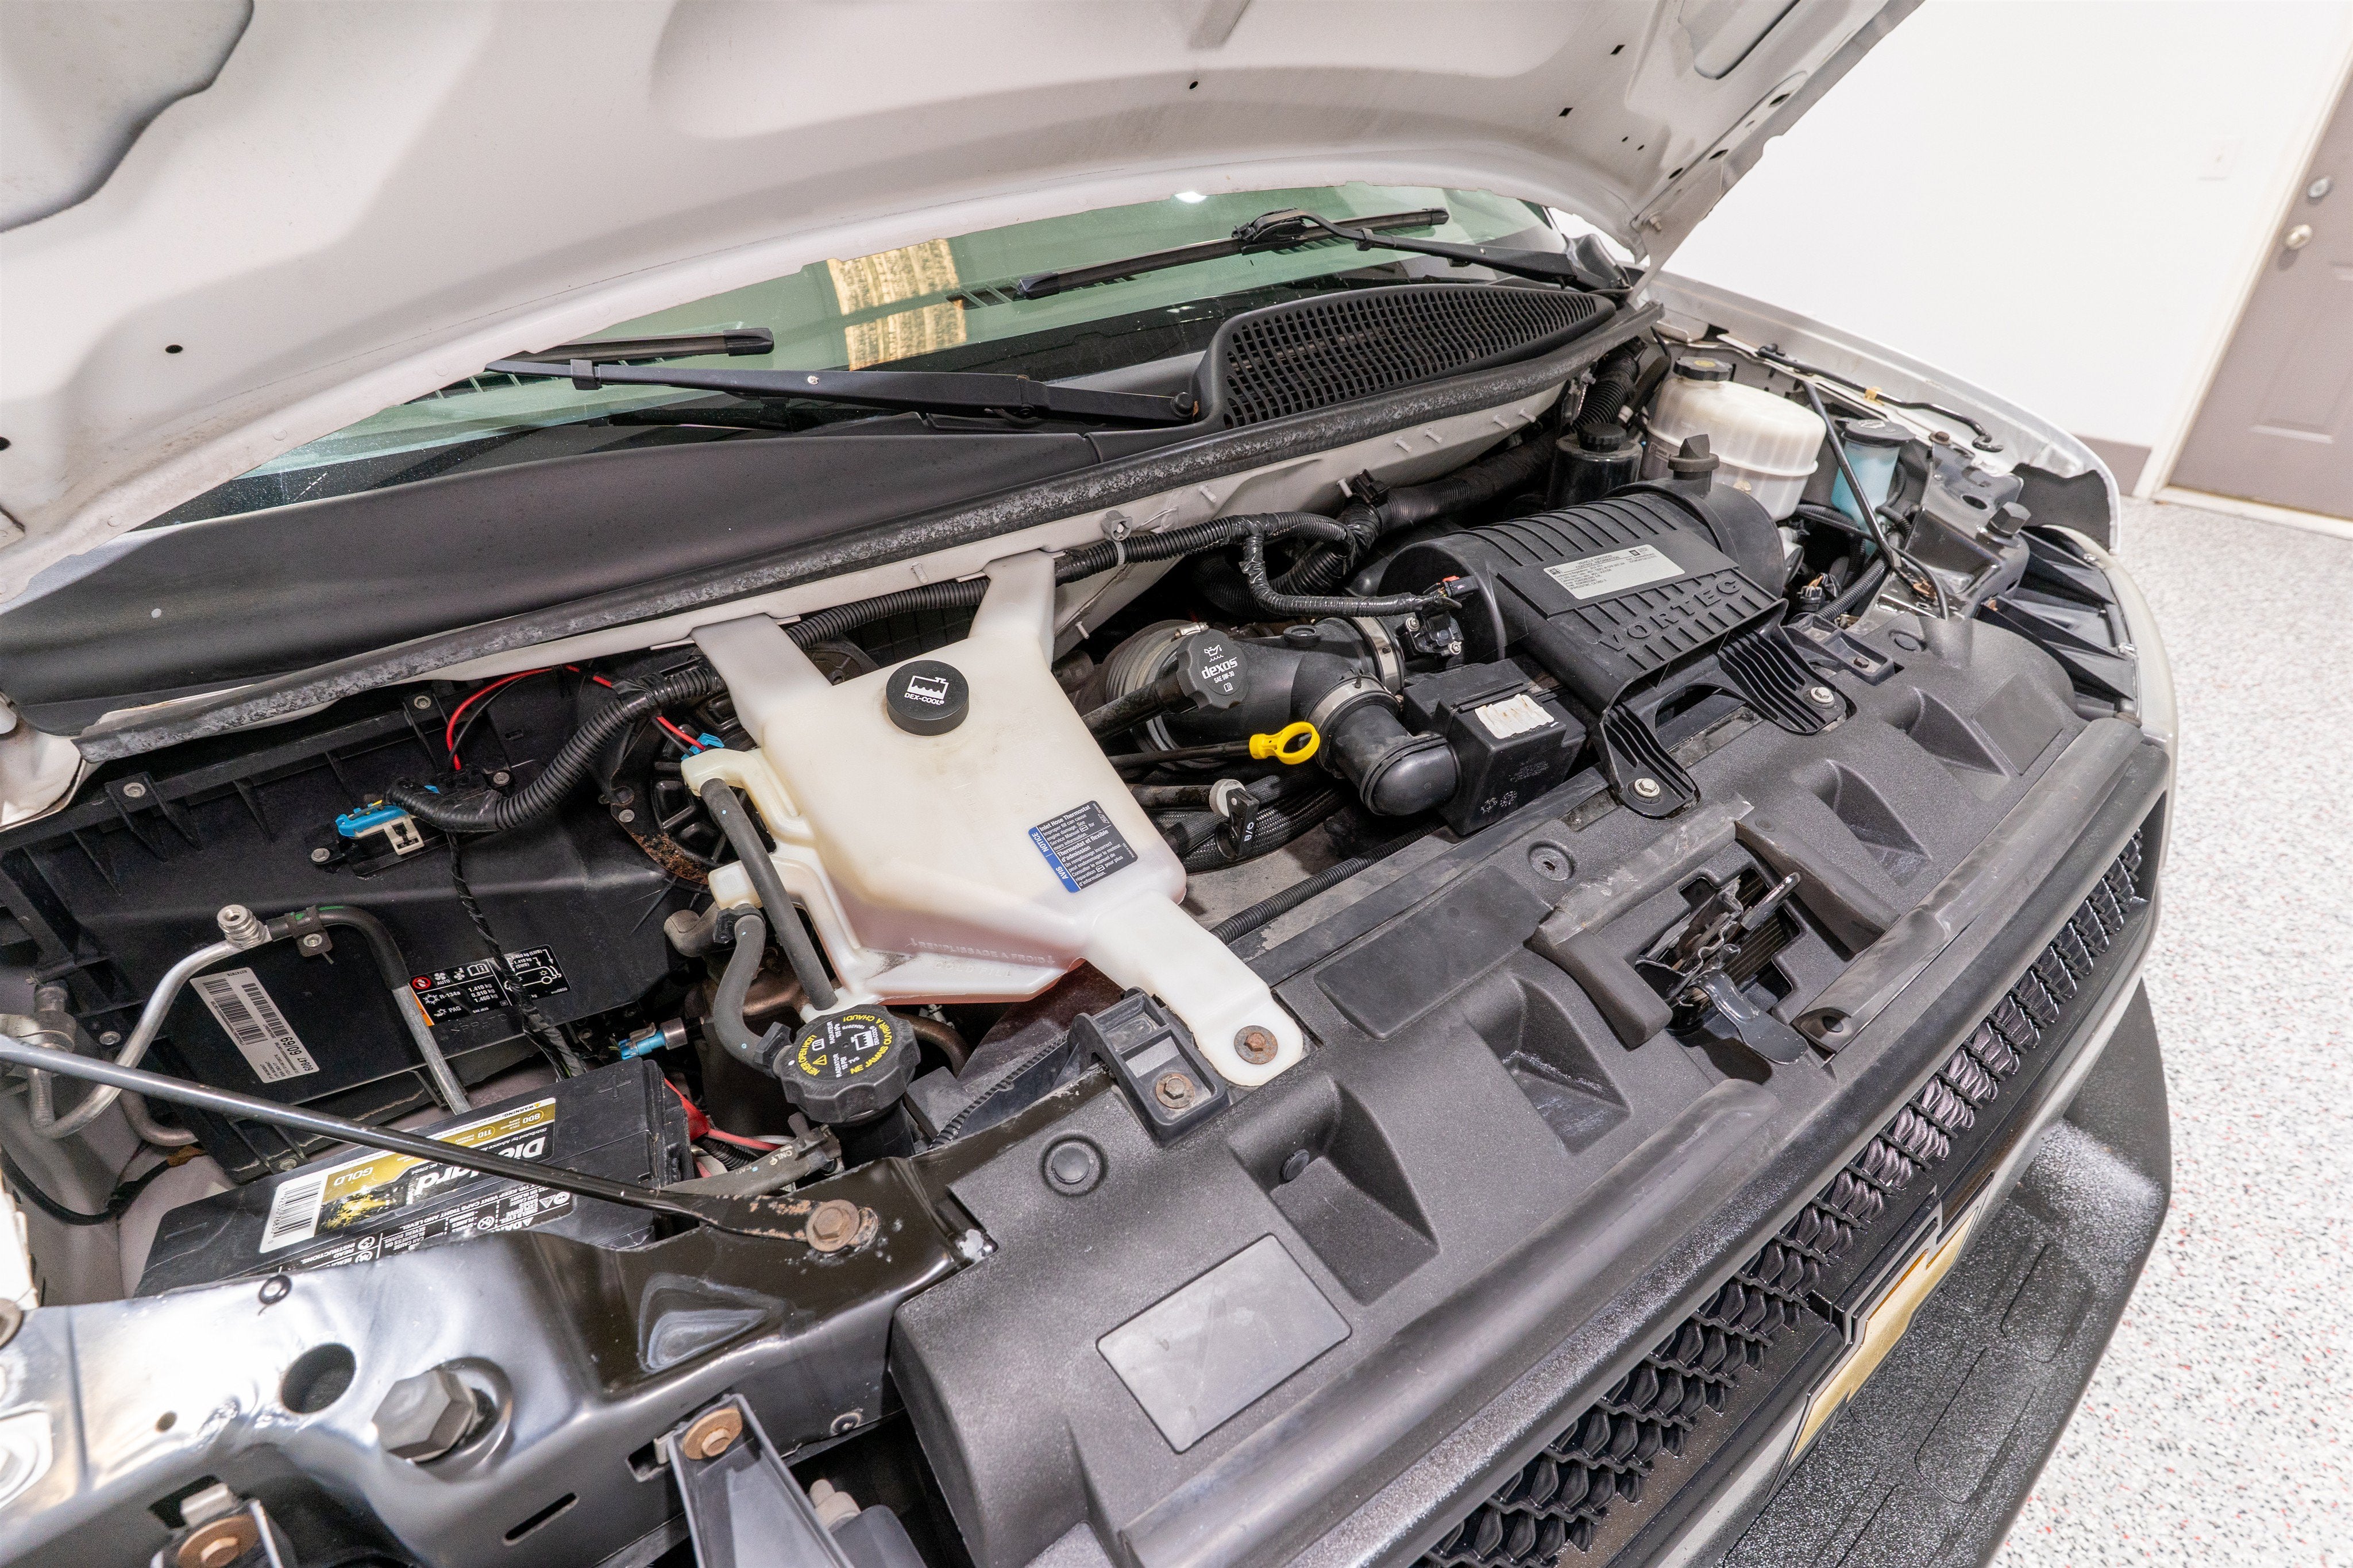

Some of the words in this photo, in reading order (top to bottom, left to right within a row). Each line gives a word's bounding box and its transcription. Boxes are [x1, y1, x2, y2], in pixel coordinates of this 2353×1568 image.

[1598, 578, 1742, 652] VORTEC
[1201, 657, 1238, 679] dexos
[1213, 675, 1223, 683] SAE
[1221, 670, 1235, 681] 5W-30
[1038, 822, 1052, 832] Inlet
[1050, 817, 1064, 827] Hose
[1062, 804, 1091, 821] Thermostat
[1042, 825, 1062, 837] Improper
[1074, 813, 1087, 822] cause
[1046, 832, 1062, 842] engine
[1059, 824, 1078, 836] damage.
[1048, 835, 1066, 847] Service
[1064, 828, 1081, 839] Manual
[1031, 831, 1050, 853] NOTICE
[1052, 843, 1065, 851] more
[1063, 831, 1088, 846] information.
[1056, 840, 1086, 858] Thermostat
[1089, 828, 1109, 841] flexible
[1060, 844, 1091, 863] d'admission
[1067, 864, 1079, 873] peut
[1077, 851, 1104, 869] endommager
[1106, 843, 1122, 853] moteur.
[1070, 849, 1096, 866] remplissage
[1093, 840, 1113, 853] incorrect
[1055, 865, 1069, 880] AVIS
[1071, 864, 1091, 878] Consulter
[1094, 855, 1110, 866] manuel
[1074, 868, 1097, 883] réparation
[1104, 859, 1115, 868] pour
[1113, 854, 1124, 863] plus
[1078, 868, 1107, 888] d'information.
[918, 941, 999, 959] REMPLISSAGE
[1010, 953, 1046, 964] FROID
[935, 961, 975, 975] COLD
[978, 966, 1012, 977] FILL
[438, 989, 461, 1000] R-134a
[467, 984, 485, 992] 1.410
[470, 989, 488, 998] 0.810
[474, 994, 491, 1003] 1.460
[448, 1005, 462, 1013] PAG
[843, 1014, 875, 1022] CHAUD!
[827, 1021, 836, 1045] RADIATEUR
[878, 1022, 893, 1045] OUVRIR
[279, 1036, 303, 1056] 60/69
[803, 1034, 817, 1048] HOT!
[798, 1047, 808, 1064] OPEN
[839, 1056, 847, 1064] PSI
[847, 1056, 861, 1065] TVS
[865, 1045, 889, 1068] JAMAIS
[296, 1056, 314, 1071] 60847
[800, 1060, 820, 1076] NEVER
[832, 1053, 843, 1078] RADIATOR
[850, 1064, 864, 1075] NE
[502, 1104, 533, 1118] WARNING:
[523, 1112, 540, 1124] 800
[478, 1128, 491, 1138] 110
[519, 1126, 546, 1140] Distributed
[489, 1138, 510, 1150] Advance
[414, 1135, 545, 1197] Dieard
[333, 1165, 373, 1186] GOLD
[499, 1188, 517, 1198] KEEP
[518, 1184, 529, 1192] TIP.
[481, 1194, 497, 1204] VENT
[509, 1191, 529, 1202] INJURY.
[509, 1198, 524, 1207] CAUSE
[526, 1193, 538, 1201] CAN
[440, 1207, 459, 1218] TIGHT
[461, 1200, 479, 1211] CAPS
[506, 1202, 538, 1216] EXPLOSIVE
[517, 1207, 537, 1218] SHIELD
[424, 1214, 439, 1223] AND
[449, 1211, 475, 1223] SMOKING
[451, 1216, 474, 1228] FLAMES
[399, 1219, 423, 1231] LEVEL.
[403, 1226, 425, 1237] SEVERE
[383, 1233, 403, 1244] BURNS.
[392, 1230, 425, 1246] BLINDNESS
[410, 1235, 423, 1245] CAN
[300, 1242, 355, 1264] INSTRUCTIONS.
[333, 1248, 353, 1258] READ
[392, 1241, 408, 1251] CAUSE
